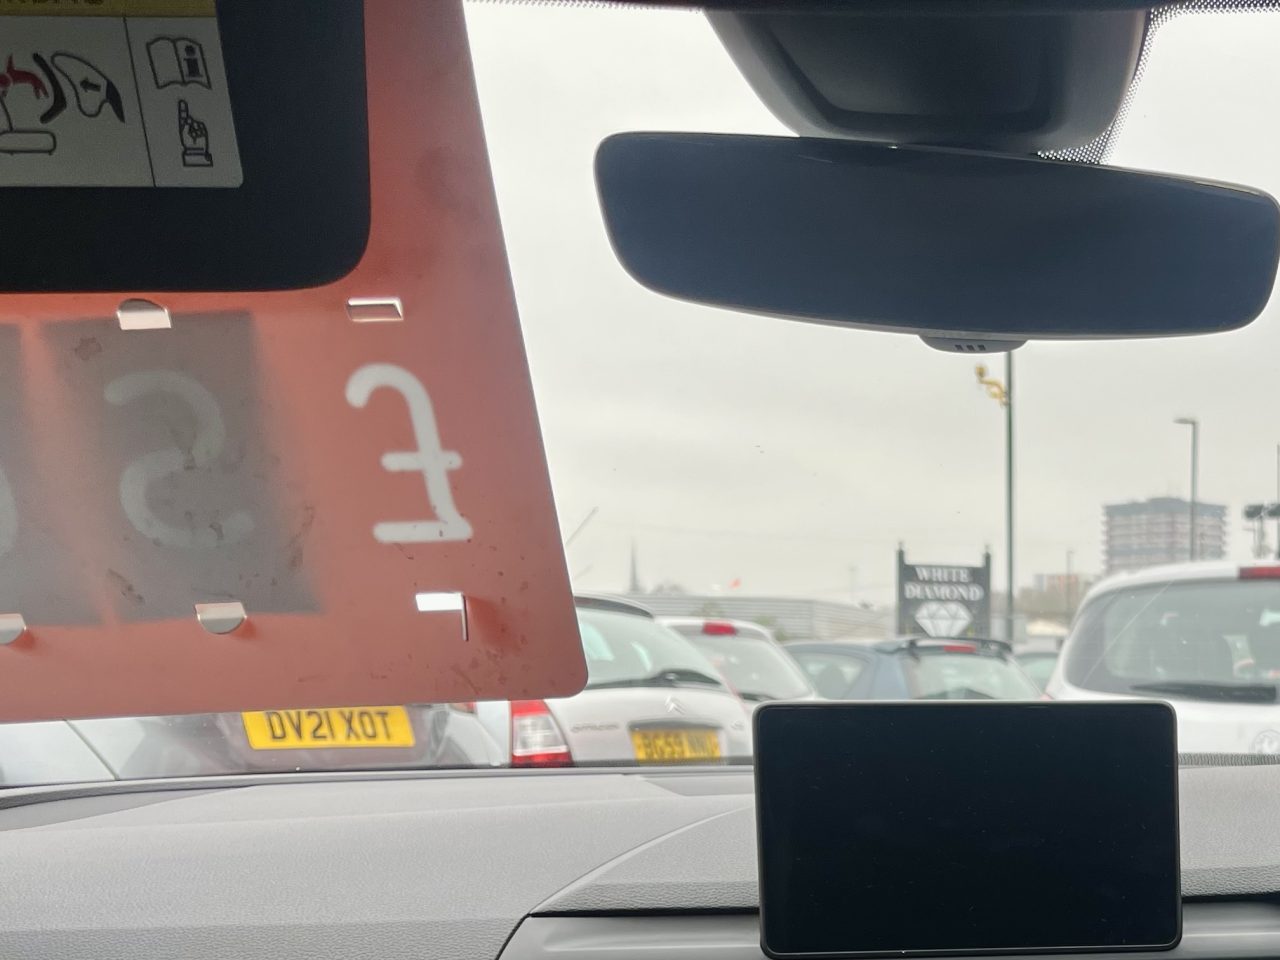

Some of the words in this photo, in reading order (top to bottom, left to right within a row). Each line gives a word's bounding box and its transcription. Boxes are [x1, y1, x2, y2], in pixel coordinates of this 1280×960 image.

[915, 566, 969, 582] WHITE
[904, 583, 984, 601] DIAMOND
[264, 710, 336, 741] DV21
[338, 709, 392, 741] XOT
